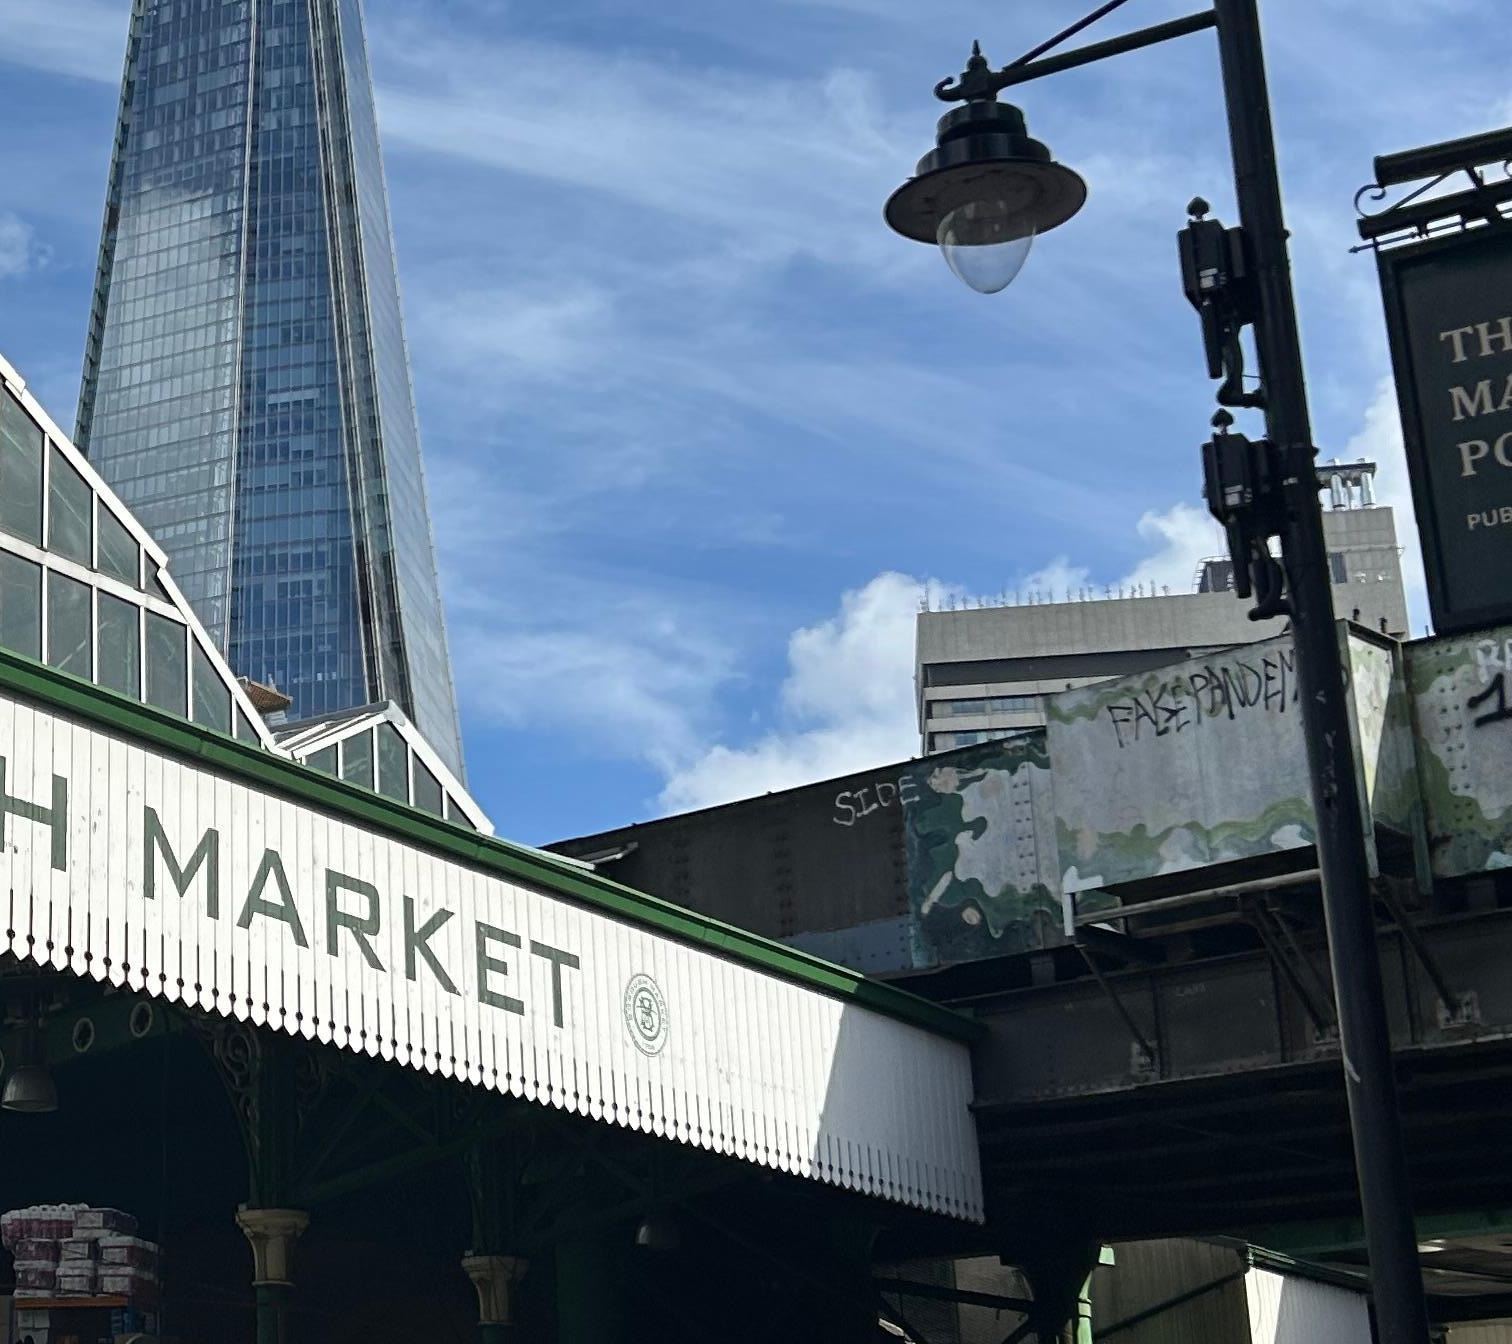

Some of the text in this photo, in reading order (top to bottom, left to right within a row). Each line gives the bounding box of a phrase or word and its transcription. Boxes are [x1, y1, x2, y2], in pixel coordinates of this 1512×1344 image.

[1440, 316, 1512, 363] TH
[1448, 372, 1512, 421] MA
[1456, 432, 1512, 477] PO
[1467, 506, 1512, 531] PUB
[143, 804, 580, 1029] MARKET
